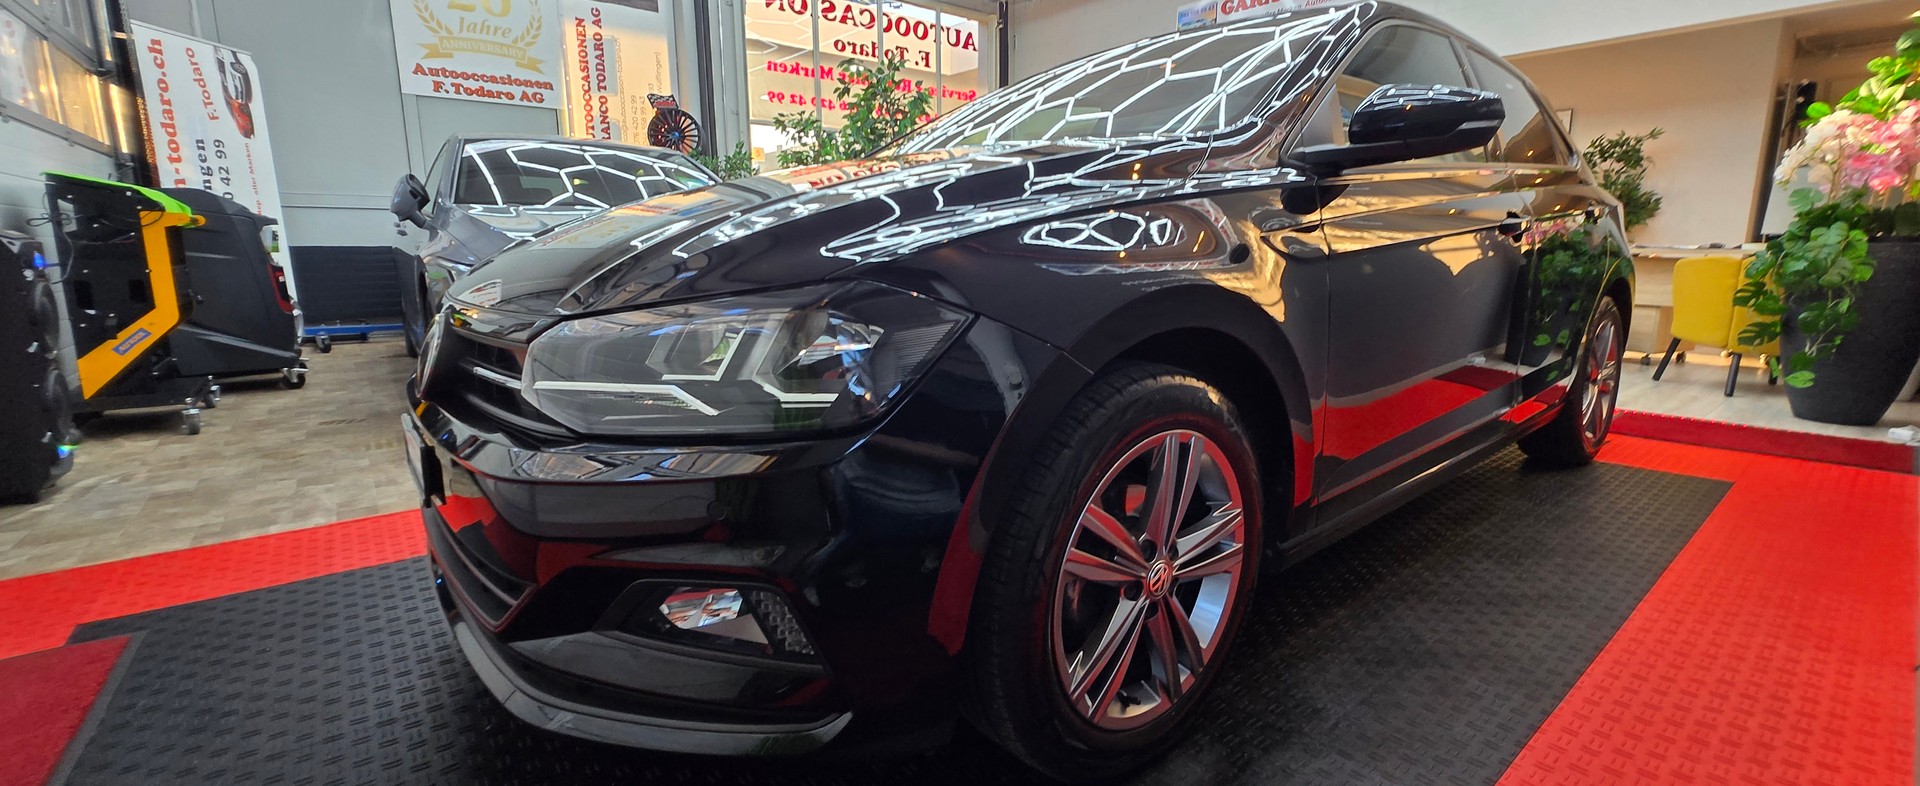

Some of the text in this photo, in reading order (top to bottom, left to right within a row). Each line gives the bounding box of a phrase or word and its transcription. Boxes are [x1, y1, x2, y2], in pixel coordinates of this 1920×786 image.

[459, 16, 512, 38] Jahre
[590, 6, 602, 29] AG
[442, 40, 525, 60] ANNIVERSARY
[592, 32, 607, 92] TODARO
[412, 62, 554, 91] Autooccasionen
[575, 16, 596, 140] UTOOCCASIONEN
[519, 91, 545, 103] AG
[213, 139, 227, 159] 99
[244, 142, 255, 175] Marken
[218, 166, 231, 188] 42
[250, 175, 259, 195] aller
